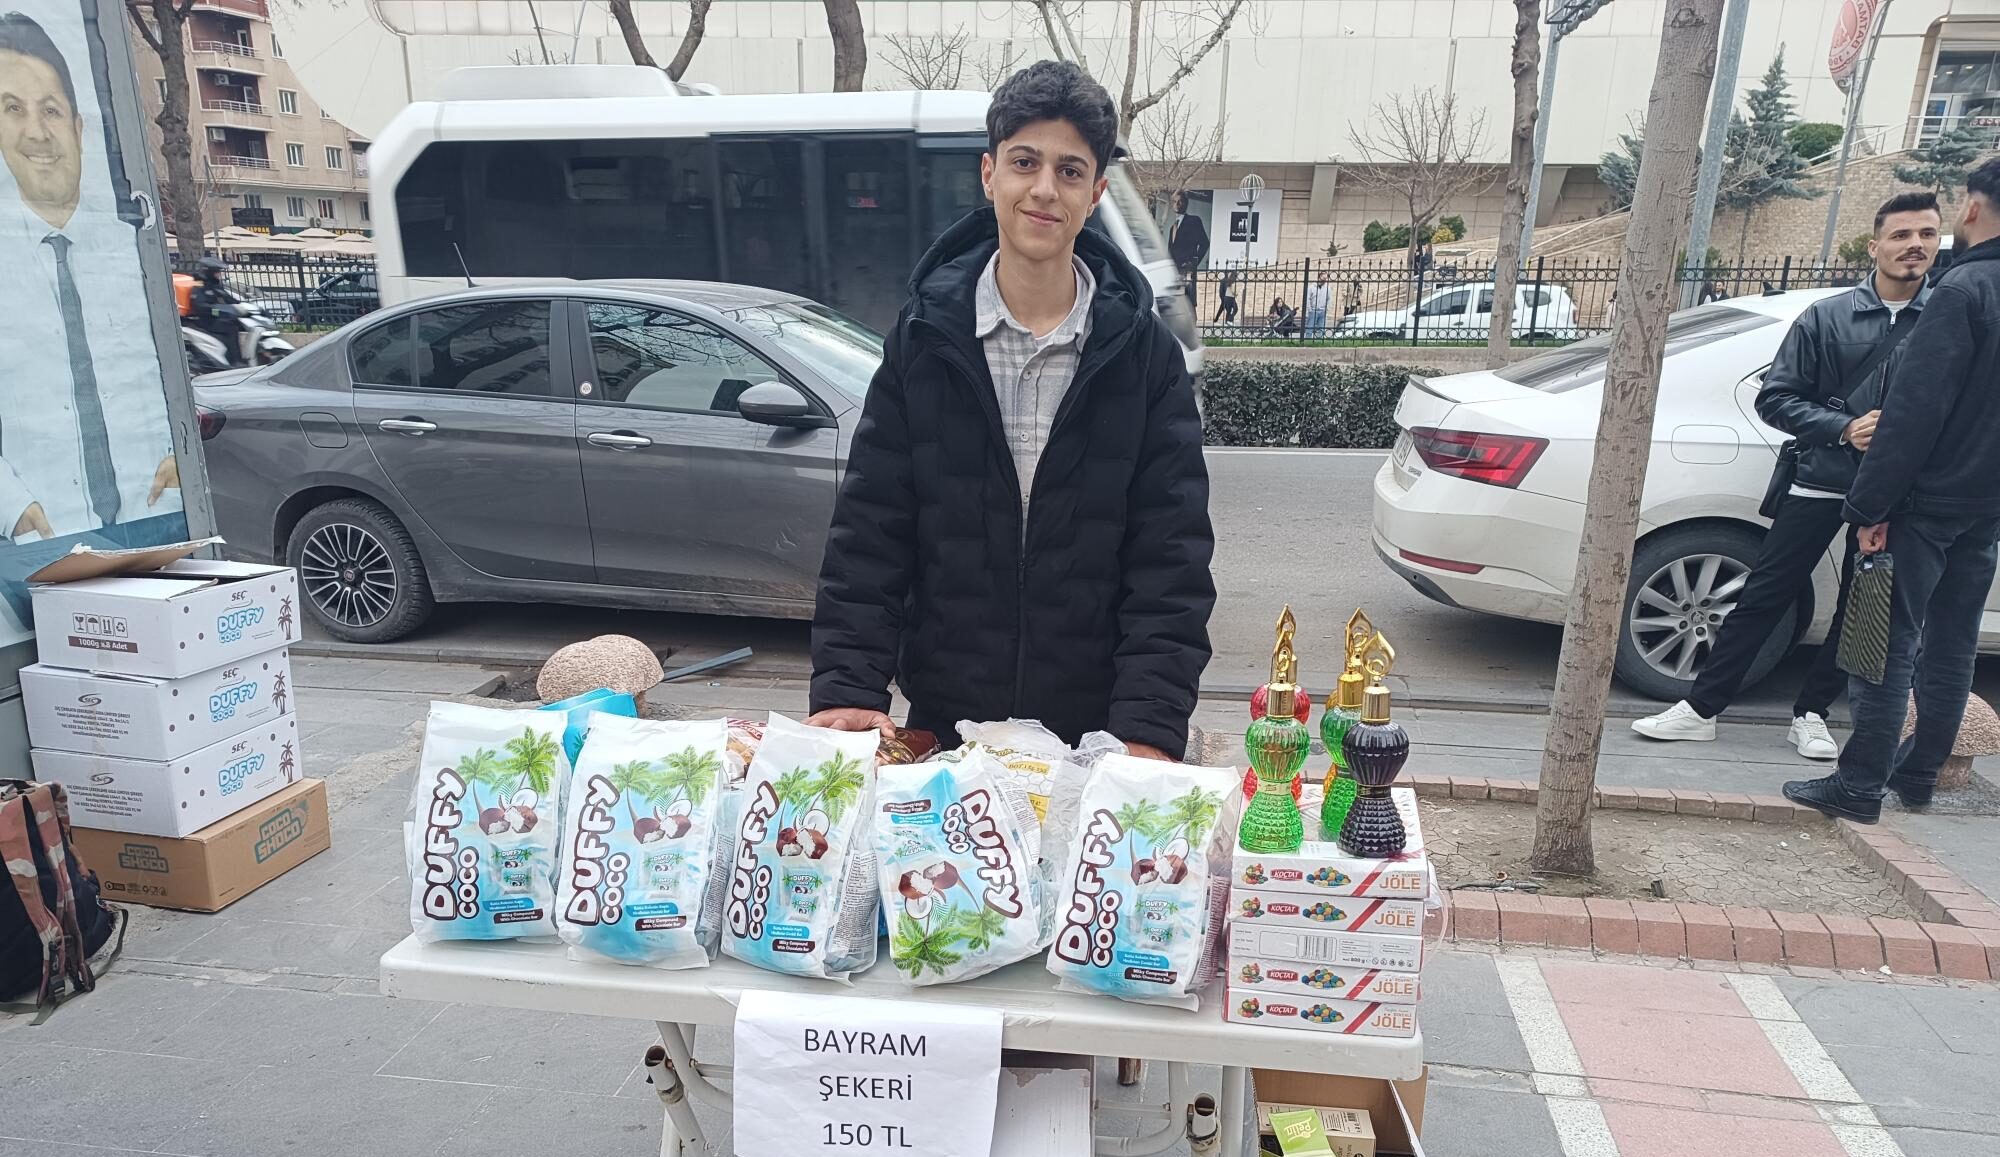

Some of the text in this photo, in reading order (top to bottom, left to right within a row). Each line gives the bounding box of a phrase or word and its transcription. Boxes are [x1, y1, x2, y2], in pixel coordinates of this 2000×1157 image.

[217, 606, 264, 634] DUFFY
[112, 642, 128, 650] Adet
[219, 629, 242, 644] COCO
[209, 682, 258, 713] DUFFY
[211, 706, 235, 723] COCO
[218, 753, 265, 787] DUFFY
[221, 780, 244, 797] COCO
[257, 821, 302, 862] SHOCO
[261, 814, 291, 839] COCO
[942, 802, 971, 855] COCO
[126, 846, 157, 859] COCO
[423, 767, 467, 921] DUFFY
[565, 774, 621, 927] DUFFY
[960, 788, 1023, 919] DUFFY
[727, 780, 780, 939] DUFFY
[457, 846, 480, 920] COCO
[600, 852, 631, 926] COCO
[1056, 808, 1124, 966] DUFFY
[1379, 874, 1421, 890] JÖLE
[749, 864, 773, 941] COCO
[1091, 890, 1123, 969] COCO
[1374, 911, 1416, 927] JÖLE
[1372, 978, 1413, 995] JÖLE
[1371, 1013, 1412, 1030] JÖLE
[804, 1028, 927, 1058] BAYRAM
[818, 1074, 913, 1102] ŞEKERİ
[822, 1123, 913, 1148] 150 TL
